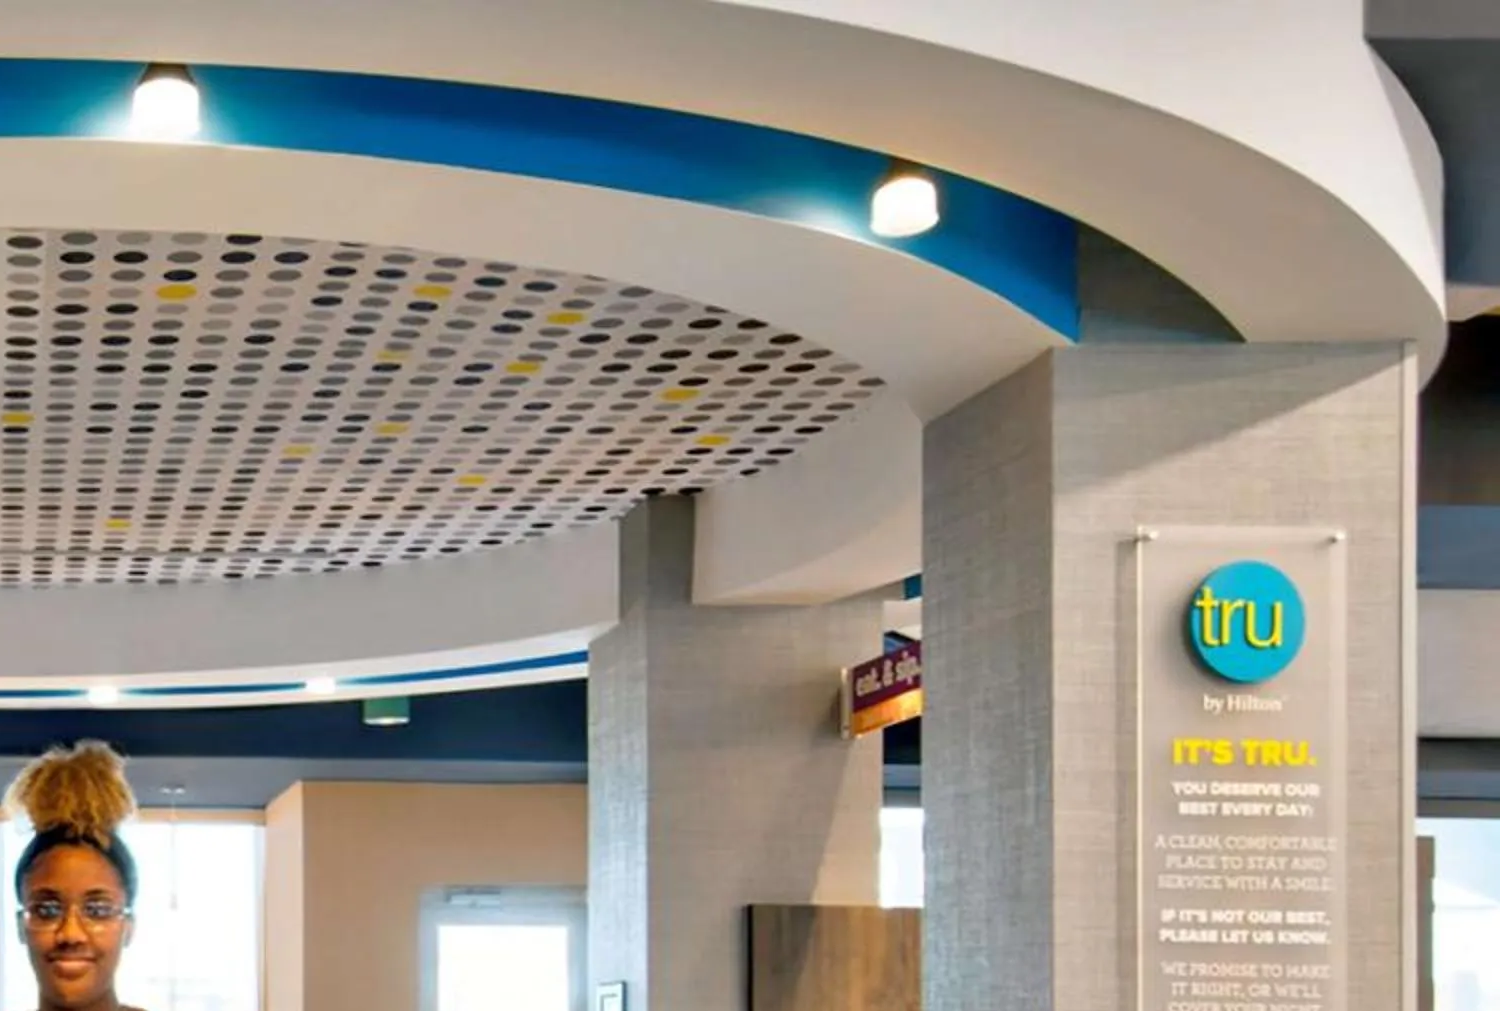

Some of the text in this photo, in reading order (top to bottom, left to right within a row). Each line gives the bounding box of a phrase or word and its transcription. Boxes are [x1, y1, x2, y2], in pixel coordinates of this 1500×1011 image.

[1195, 586, 1283, 648] tru
[1203, 694, 1283, 714] by Hilton
[1172, 738, 1317, 767] IT'S TRU.
[1172, 782, 1320, 797] YOU DESERVE OUR
[1179, 802, 1217, 816] BEST
[1222, 802, 1273, 816] EVERY
[1154, 835, 1166, 849] A
[1225, 836, 1338, 851] COMFORTABLE
[1166, 855, 1327, 871] PLACE TO STAY AND
[1158, 875, 1222, 890] SERVICE
[1224, 876, 1267, 891] WITH
[1270, 876, 1282, 890] A
[1161, 909, 1177, 923] IF
[1180, 909, 1207, 923] IT'S
[1211, 909, 1244, 924] NOT
[1247, 910, 1282, 924] OUR
[1159, 929, 1218, 943] PLEASE
[1222, 929, 1250, 943] LET
[1252, 930, 1274, 944] US
[1161, 962, 1332, 979] WE PROMISE TO MAKE
[1171, 981, 1188, 996] IT
[1248, 983, 1271, 998] OR
